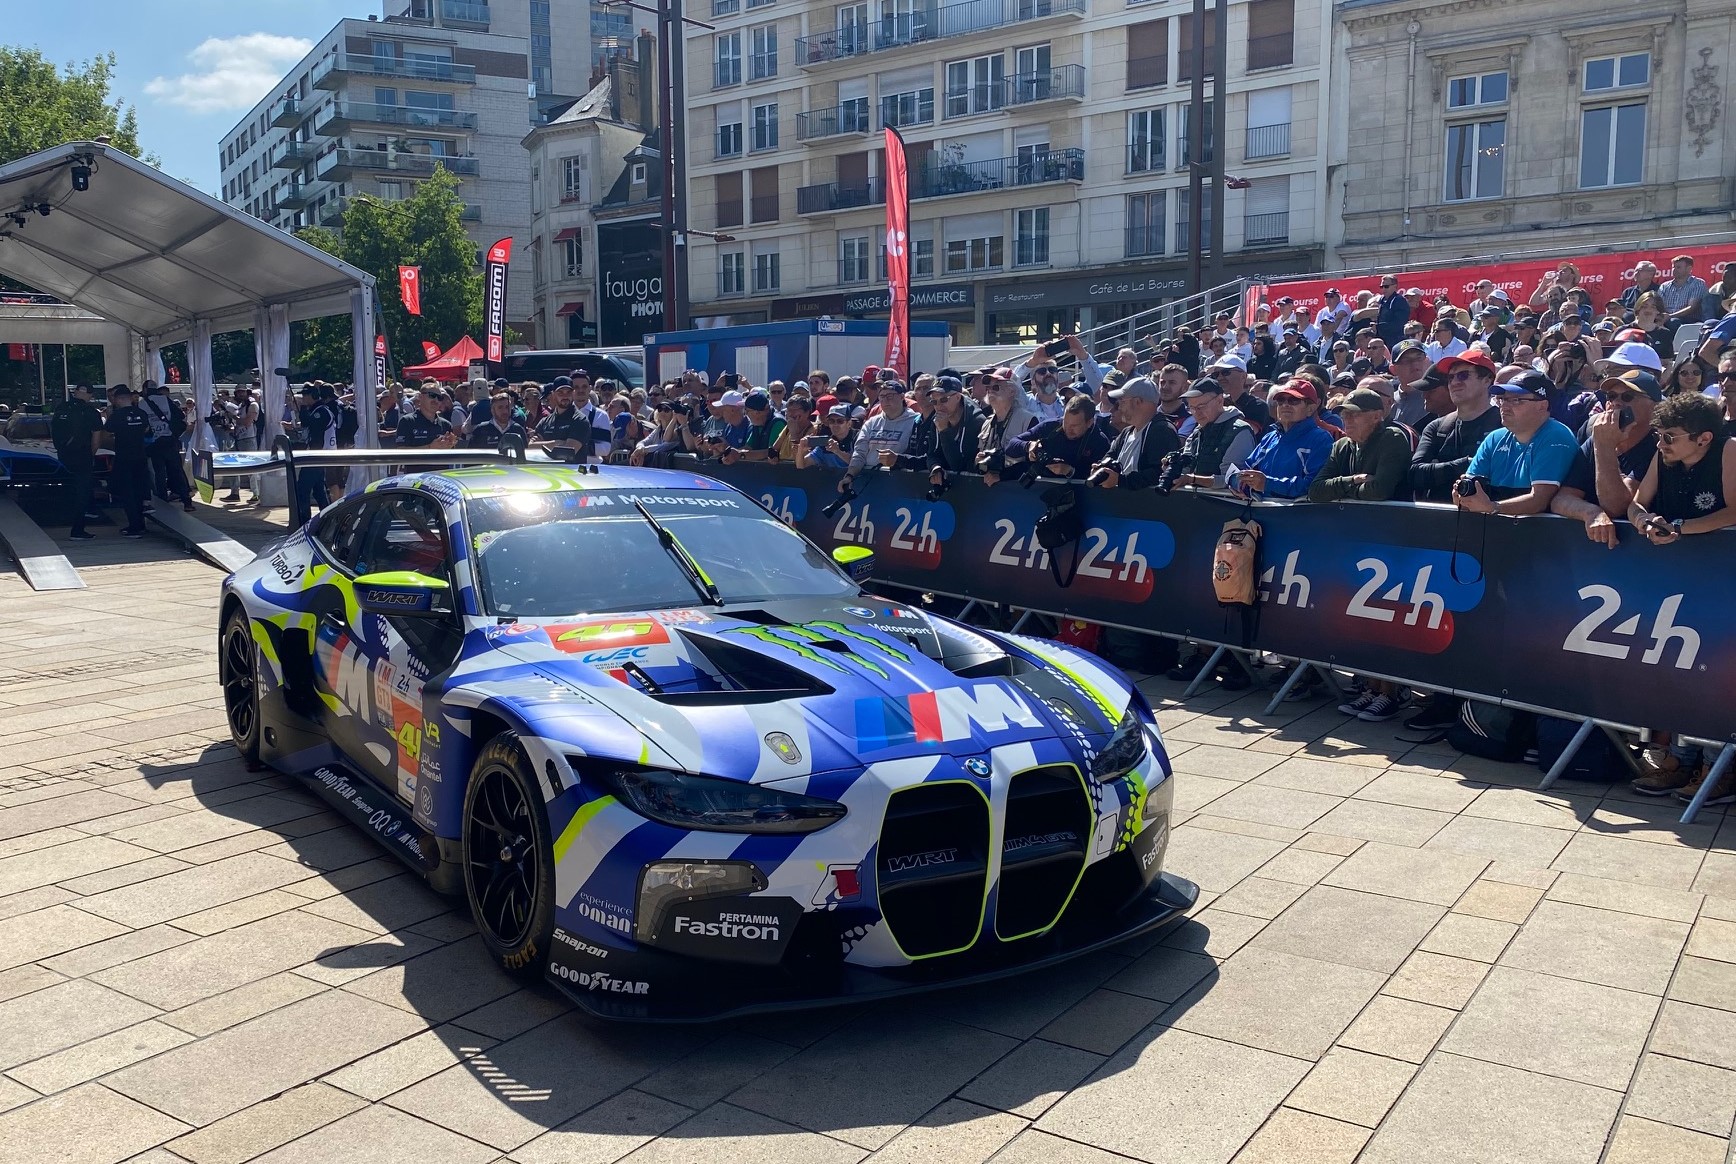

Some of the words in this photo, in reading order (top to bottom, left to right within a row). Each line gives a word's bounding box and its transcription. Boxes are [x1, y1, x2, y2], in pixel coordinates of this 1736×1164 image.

[993, 294, 1006, 303] Bar
[1008, 292, 1045, 302] Restaurant
[1089, 283, 1113, 295] Café
[1116, 283, 1128, 293] de
[1132, 281, 1145, 291] La
[1148, 279, 1185, 290] Bourse
[491, 266, 504, 336] FACOM
[846, 296, 881, 311] PASSAGE
[909, 290, 967, 305] OMMERCE
[618, 494, 740, 509] Motorsport
[833, 501, 876, 545] 24h
[890, 506, 937, 553] 24h
[270, 554, 293, 580] TURBO
[1076, 527, 1148, 584] 24h
[1258, 549, 1311, 609] 4h
[367, 590, 425, 606] WRT
[1346, 557, 1445, 630] 24h
[868, 623, 933, 636] Motorsport
[1562, 584, 1701, 670] 24h
[582, 646, 649, 664] WEC
[396, 674, 411, 693] 24h
[314, 767, 357, 800] GOODYEAR
[420, 763, 443, 783] Omantel
[887, 848, 958, 873] WRT
[580, 891, 633, 917] experience
[578, 902, 631, 934] oman
[674, 916, 779, 941] Fastron
[719, 912, 780, 925] PERTAMINA
[552, 928, 608, 959] Snap-on
[550, 961, 650, 995] GOODYEAR
